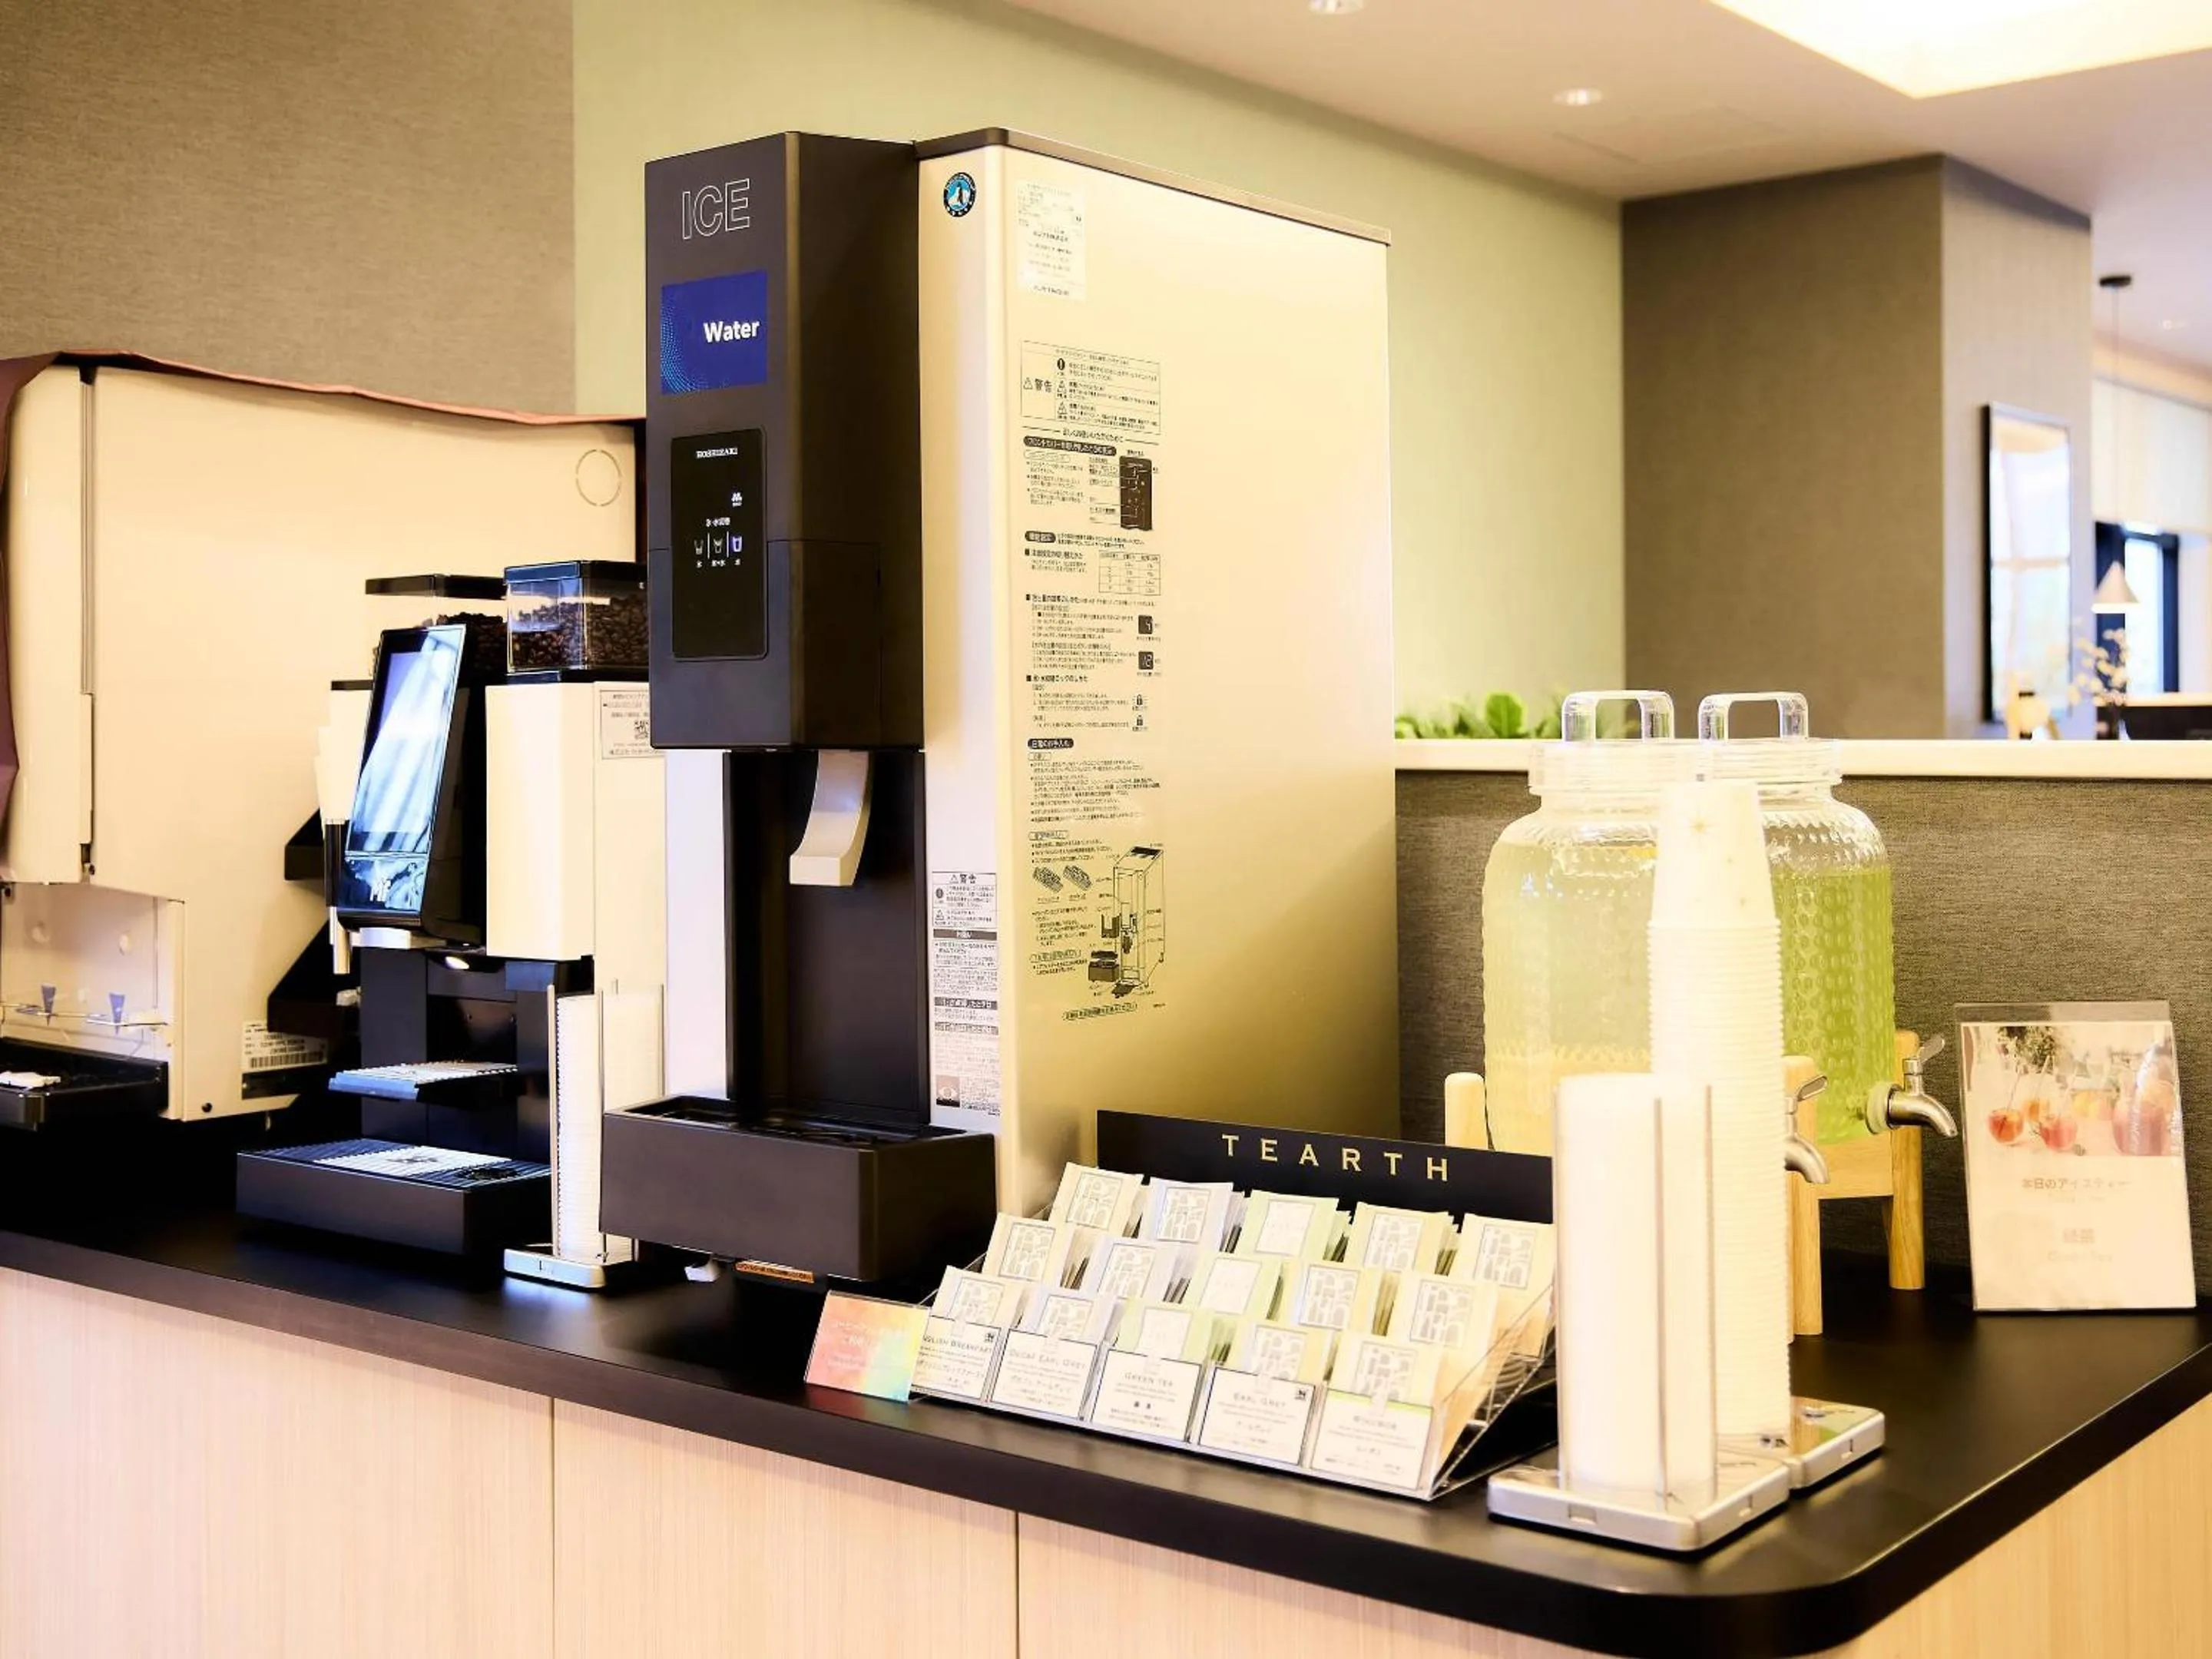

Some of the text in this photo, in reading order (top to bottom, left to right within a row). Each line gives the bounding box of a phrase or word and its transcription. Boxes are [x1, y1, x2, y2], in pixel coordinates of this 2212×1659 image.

[682, 178, 750, 240] ICE
[704, 319, 760, 343] Water
[1222, 1134, 1449, 1181] TEARTH
